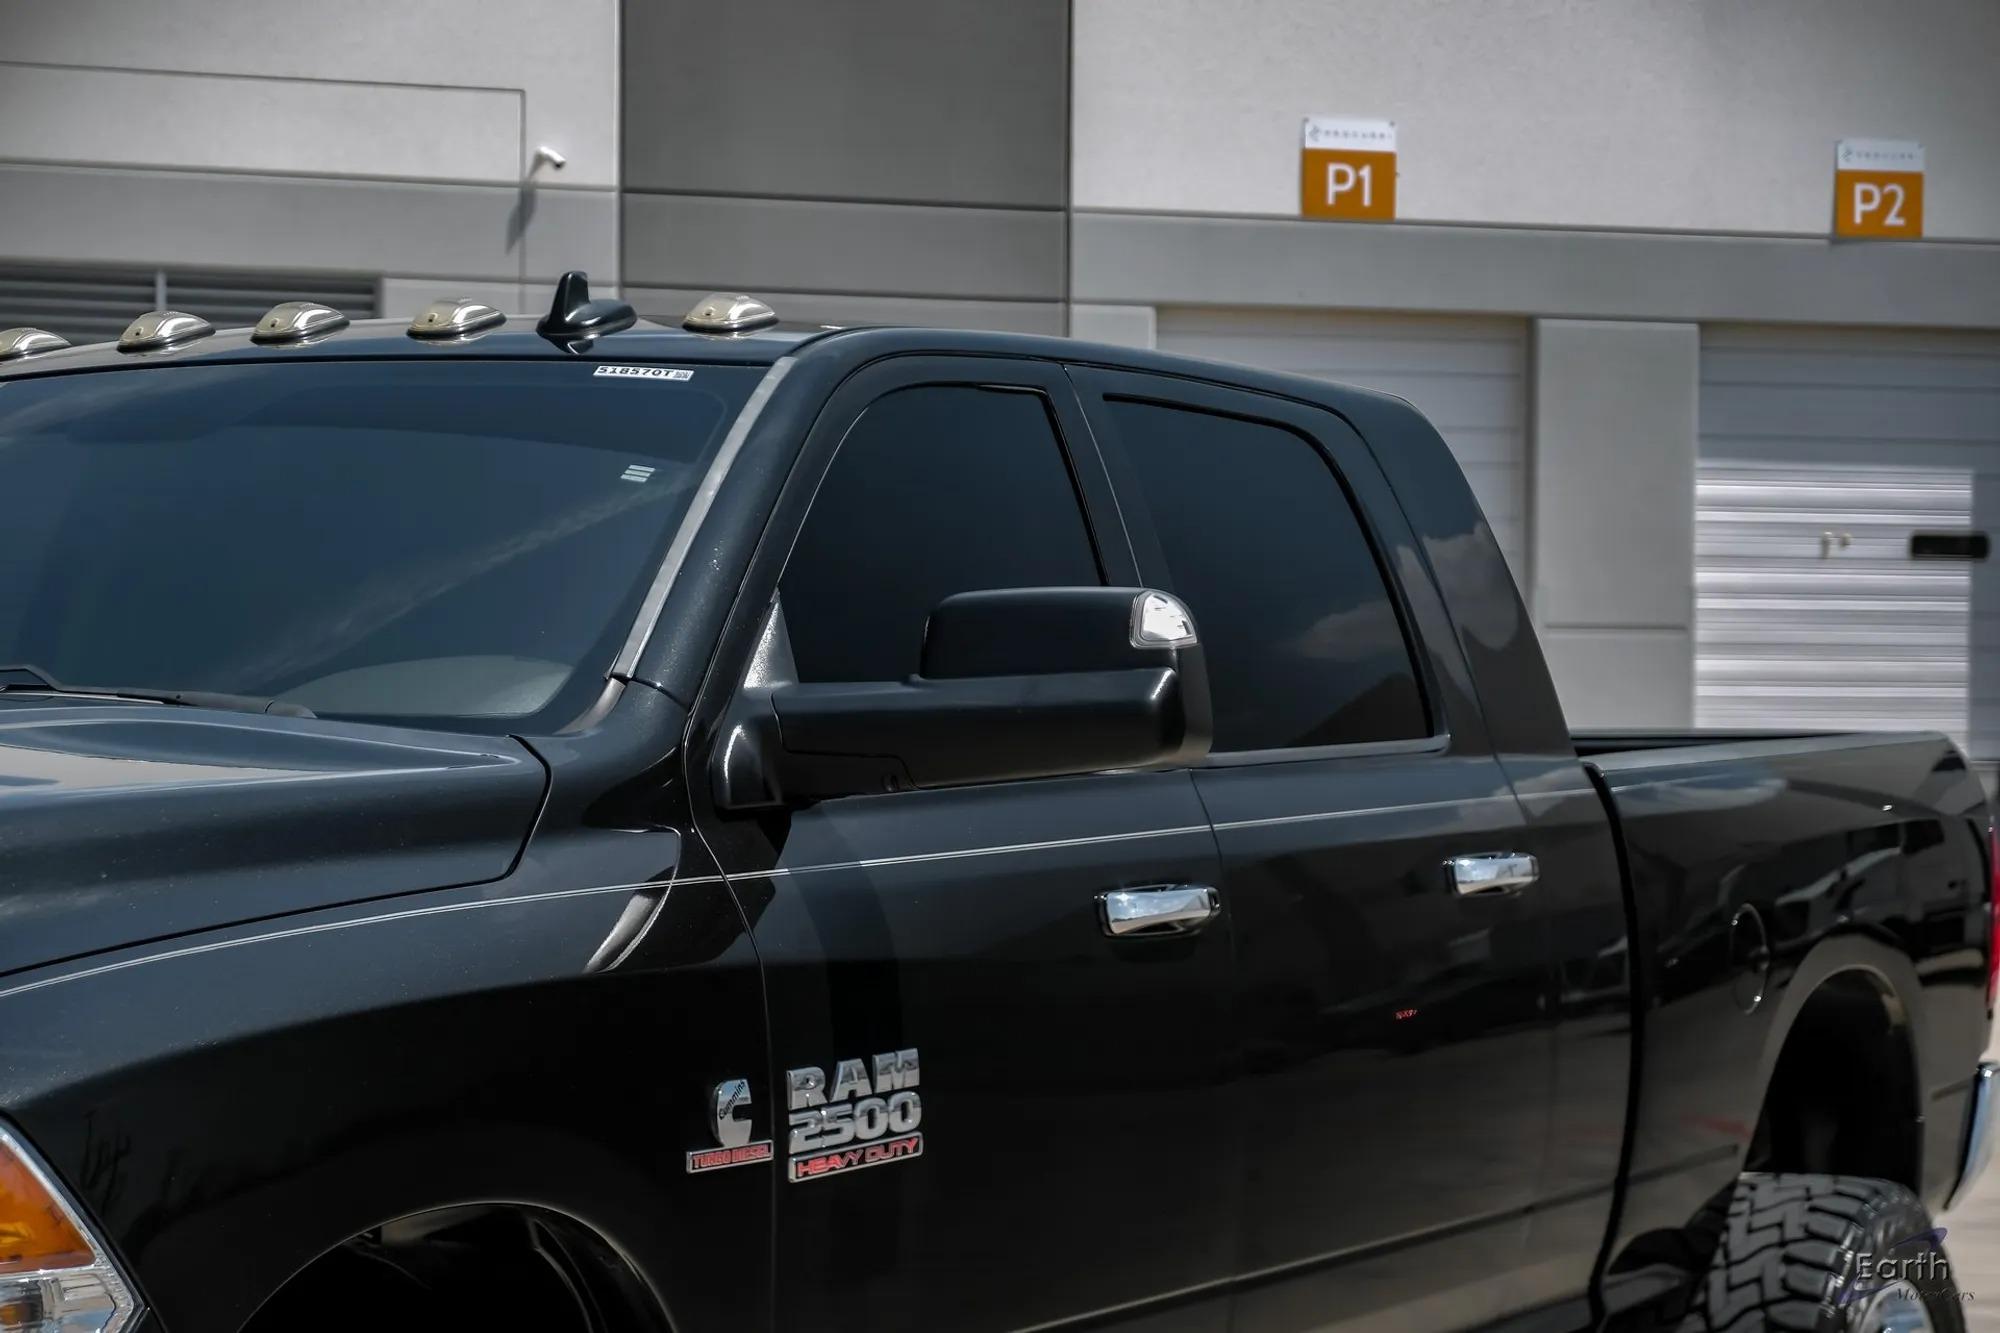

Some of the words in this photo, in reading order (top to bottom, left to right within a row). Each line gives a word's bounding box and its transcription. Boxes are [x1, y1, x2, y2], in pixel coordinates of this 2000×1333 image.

[1327, 161, 1372, 207] P1
[1854, 182, 1905, 226] P2
[719, 1080, 745, 1120] Cummins
[787, 1048, 920, 1110] RAM
[788, 1091, 922, 1154] 2500
[797, 1149, 863, 1177] HEAVY
[864, 1137, 918, 1163] DUTY
